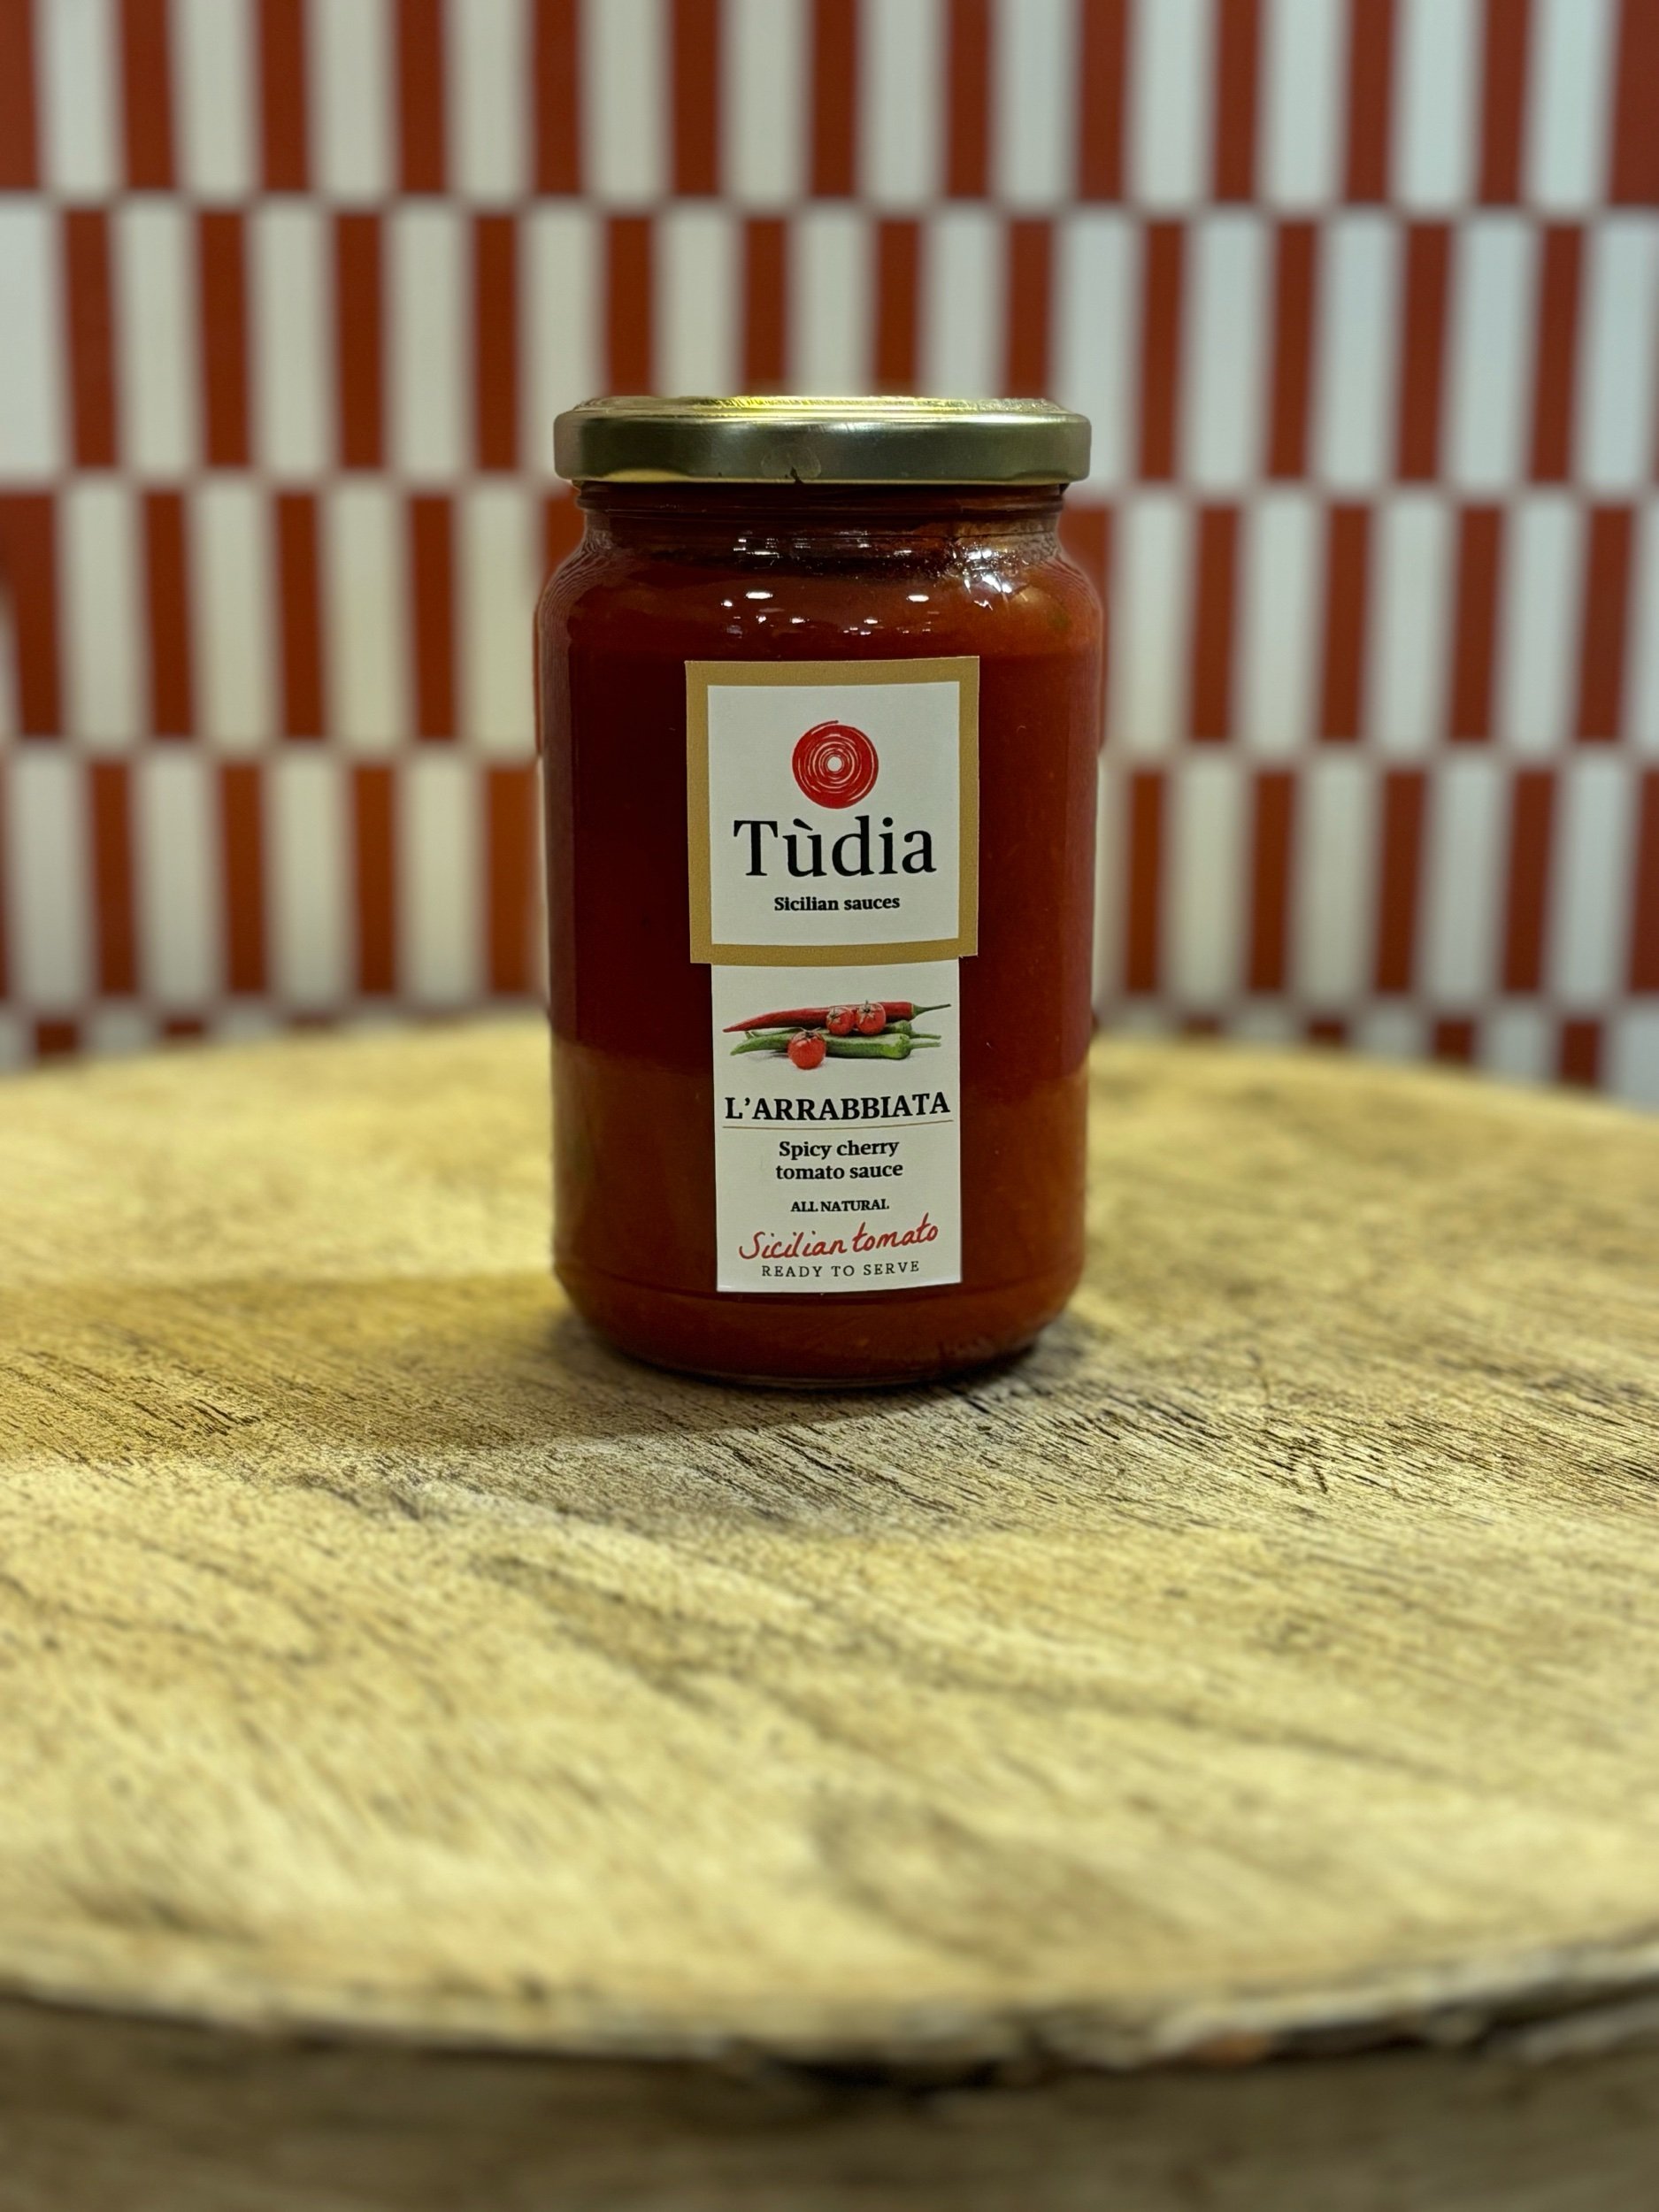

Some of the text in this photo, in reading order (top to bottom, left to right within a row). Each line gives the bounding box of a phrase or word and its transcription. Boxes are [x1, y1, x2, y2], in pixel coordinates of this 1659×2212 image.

[733, 815, 937, 878] Tùdia
[773, 895, 901, 911] Sicilian sauces
[779, 1140, 900, 1161] Spicy cherry
[775, 1164, 903, 1180] tomato sauce
[790, 1198, 889, 1213] ALL NATURAL
[739, 1212, 939, 1260] Sicilian tomato
[761, 1260, 920, 1278] READY TO SERVE
